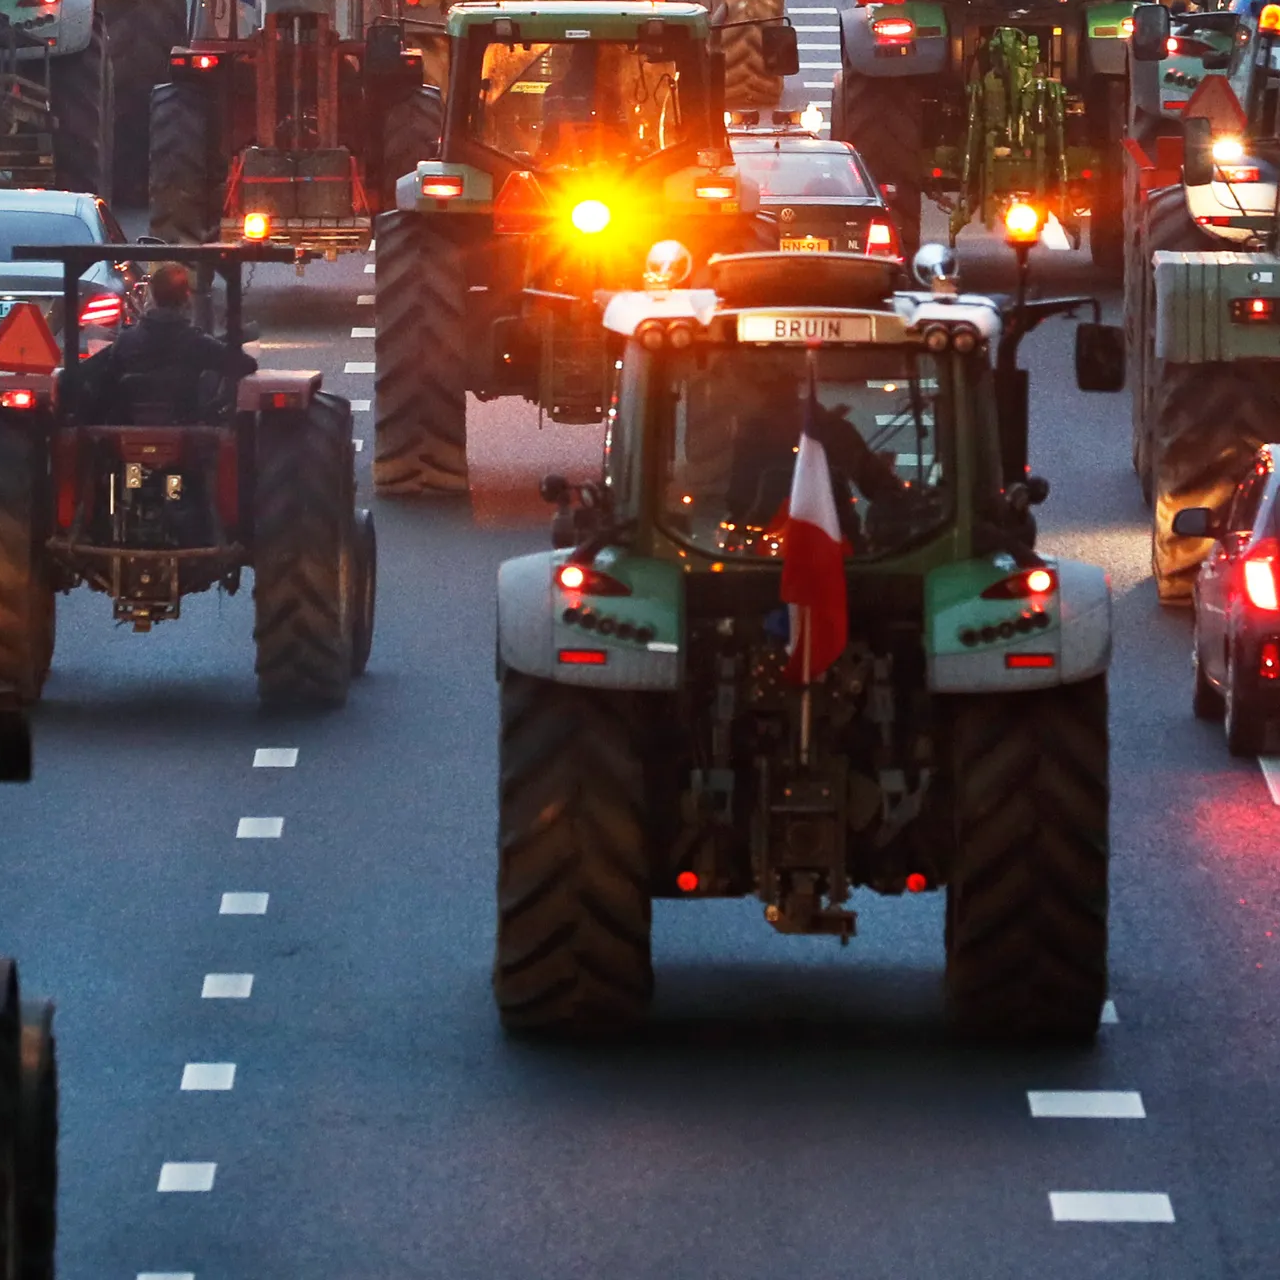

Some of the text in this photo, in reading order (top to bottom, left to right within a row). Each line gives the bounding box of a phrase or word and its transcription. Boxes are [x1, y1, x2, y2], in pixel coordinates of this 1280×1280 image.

[782, 242, 821, 252] HN-91
[847, 240, 860, 249] NL
[775, 320, 840, 338] BRUIN
